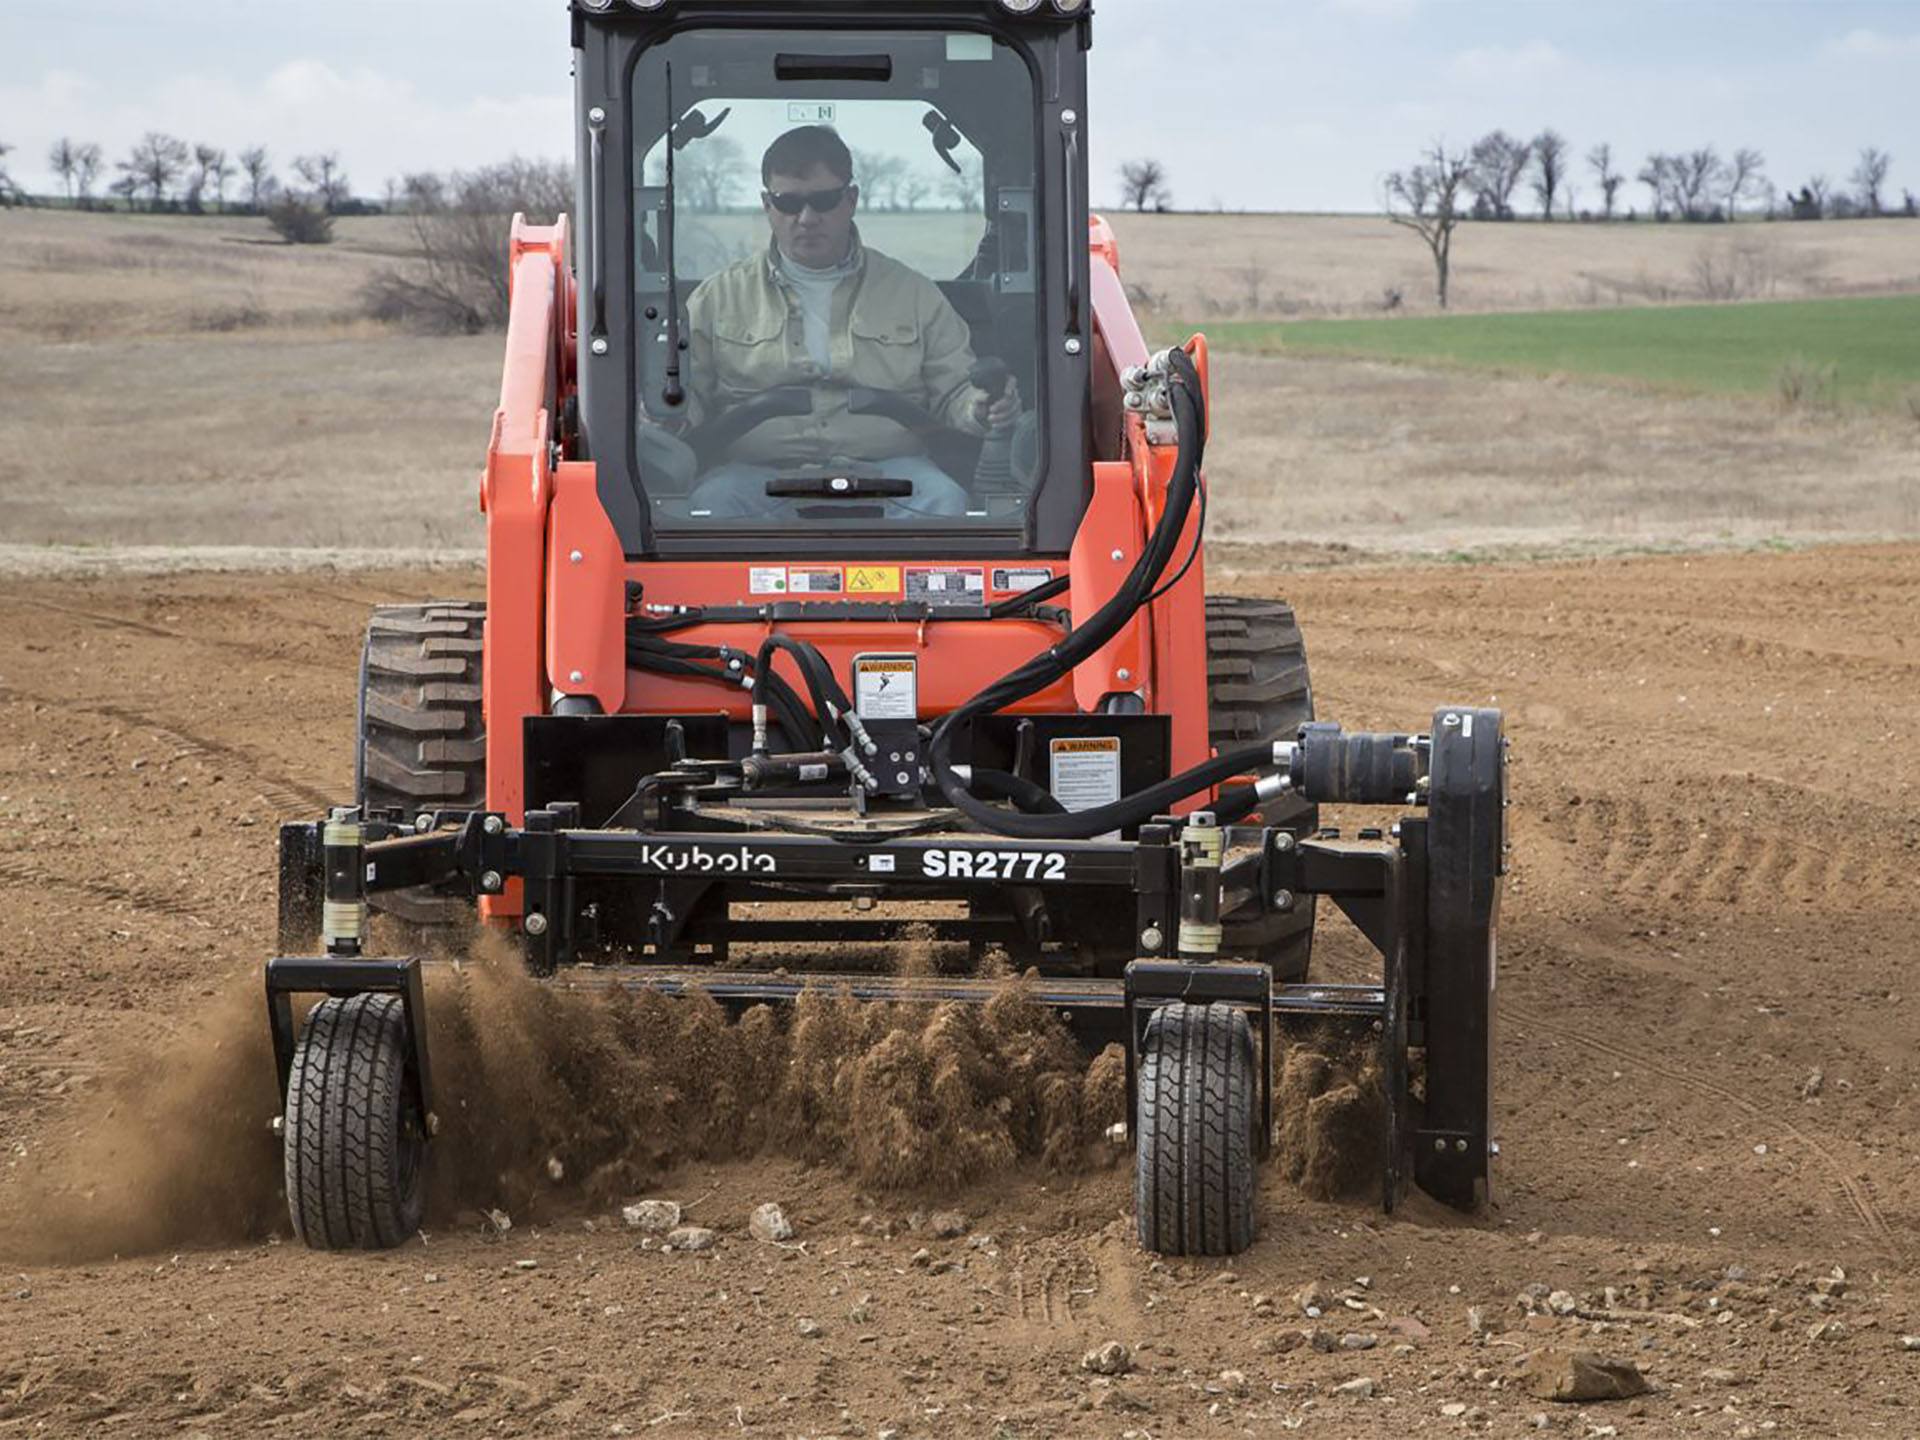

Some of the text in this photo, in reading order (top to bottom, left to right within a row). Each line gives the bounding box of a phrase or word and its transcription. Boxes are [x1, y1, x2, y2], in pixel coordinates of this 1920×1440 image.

[871, 662, 912, 672] WARNING
[1070, 741, 1113, 751] WARNING
[642, 845, 776, 873] Kubota
[922, 850, 1066, 880] SR2772
